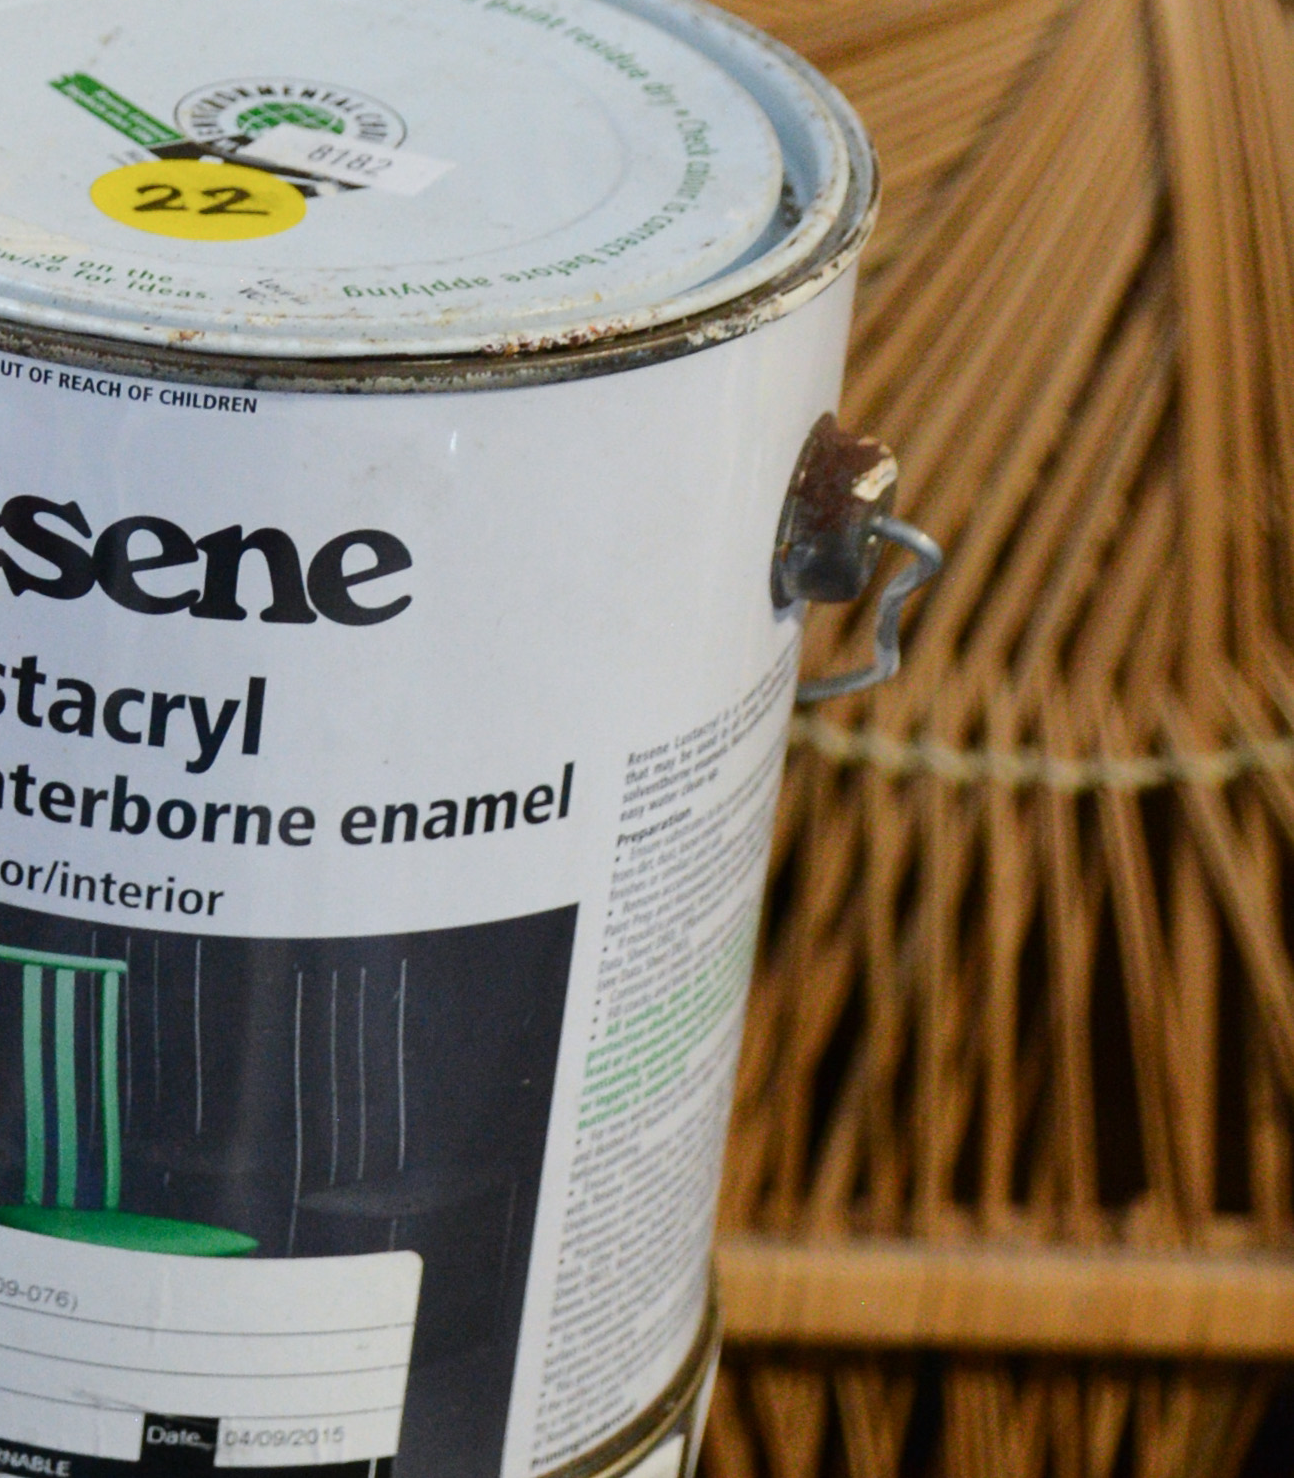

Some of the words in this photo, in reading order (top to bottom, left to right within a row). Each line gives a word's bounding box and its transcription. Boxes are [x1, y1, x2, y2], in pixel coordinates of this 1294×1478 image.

[307, 143, 393, 177] 8182
[132, 183, 271, 216] 22
[73, 269, 117, 286] for
[79, 260, 114, 273] on
[127, 268, 173, 284] the
[343, 275, 493, 300] applying
[28, 364, 55, 385] OF
[58, 371, 122, 399] REACH
[127, 382, 155, 403] OF
[158, 387, 258, 415] CHILDREN
[340, 760, 576, 846] enamel
[146, 1423, 202, 1447] Date
[223, 1426, 346, 1449] 04/09/2015
